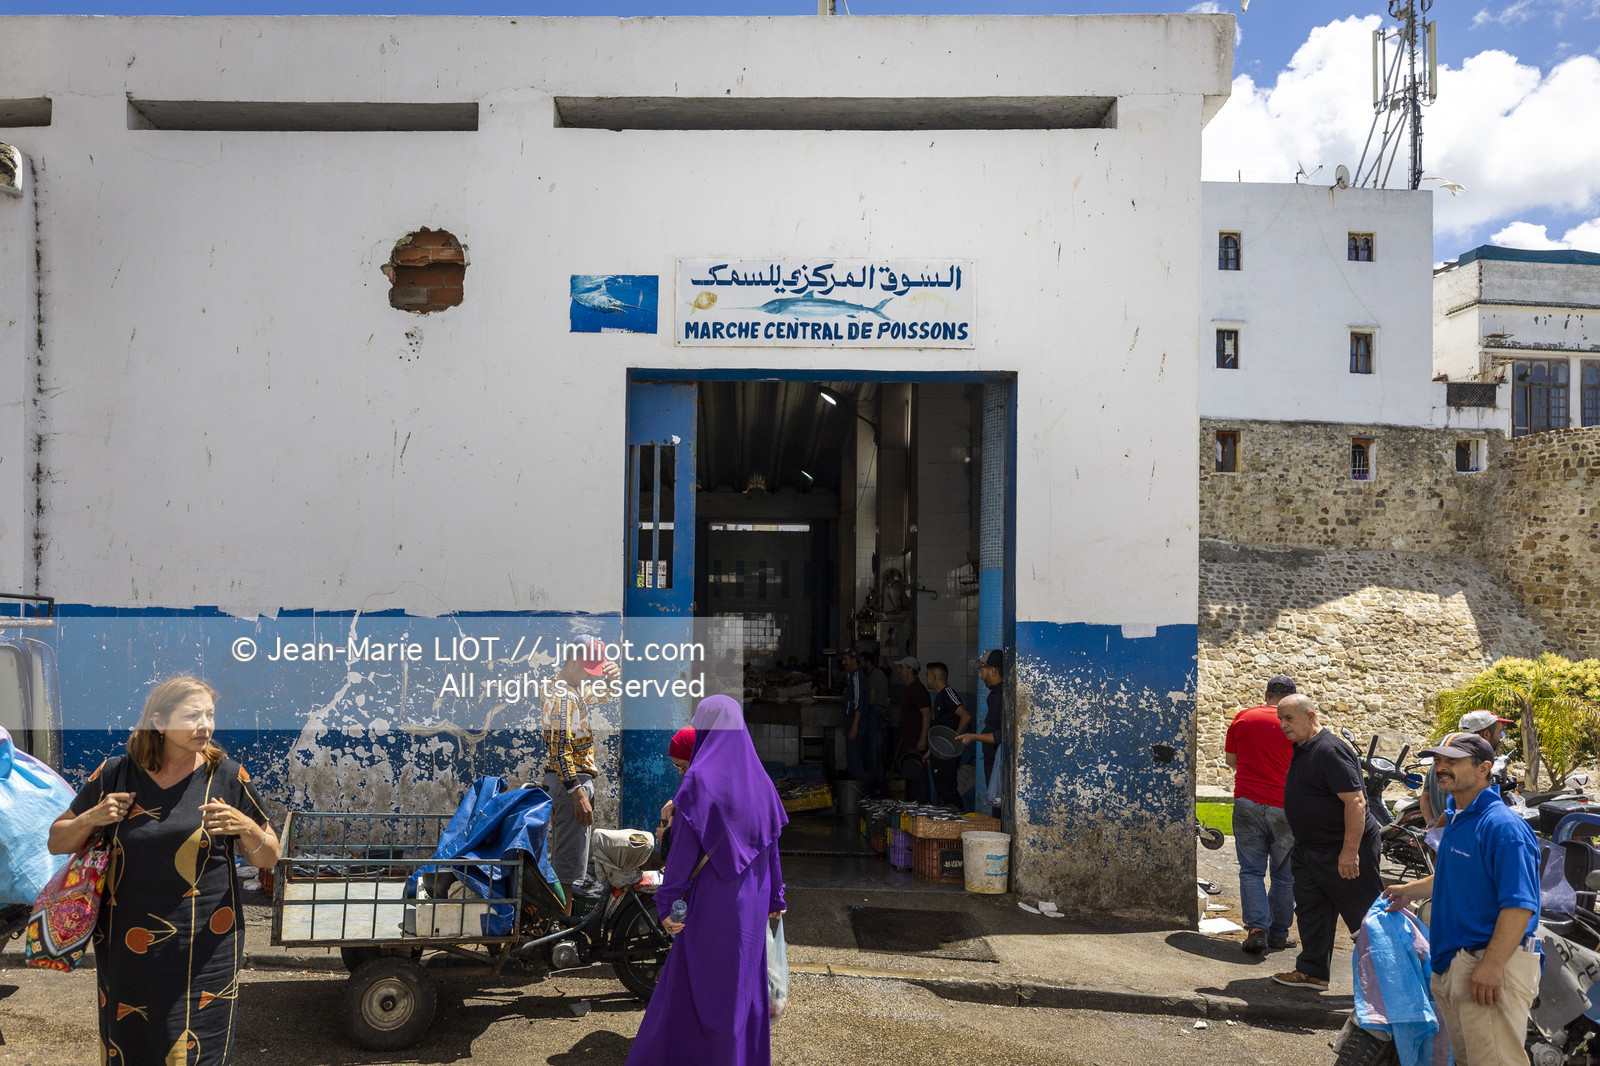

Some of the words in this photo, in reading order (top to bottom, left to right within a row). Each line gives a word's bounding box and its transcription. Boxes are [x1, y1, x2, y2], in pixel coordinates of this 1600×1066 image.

[879, 264, 962, 296] السوق
[684, 321, 762, 341] MARCHE
[764, 321, 844, 341] CENTRAL
[847, 321, 872, 340] DE
[876, 321, 969, 341] POISSONS
